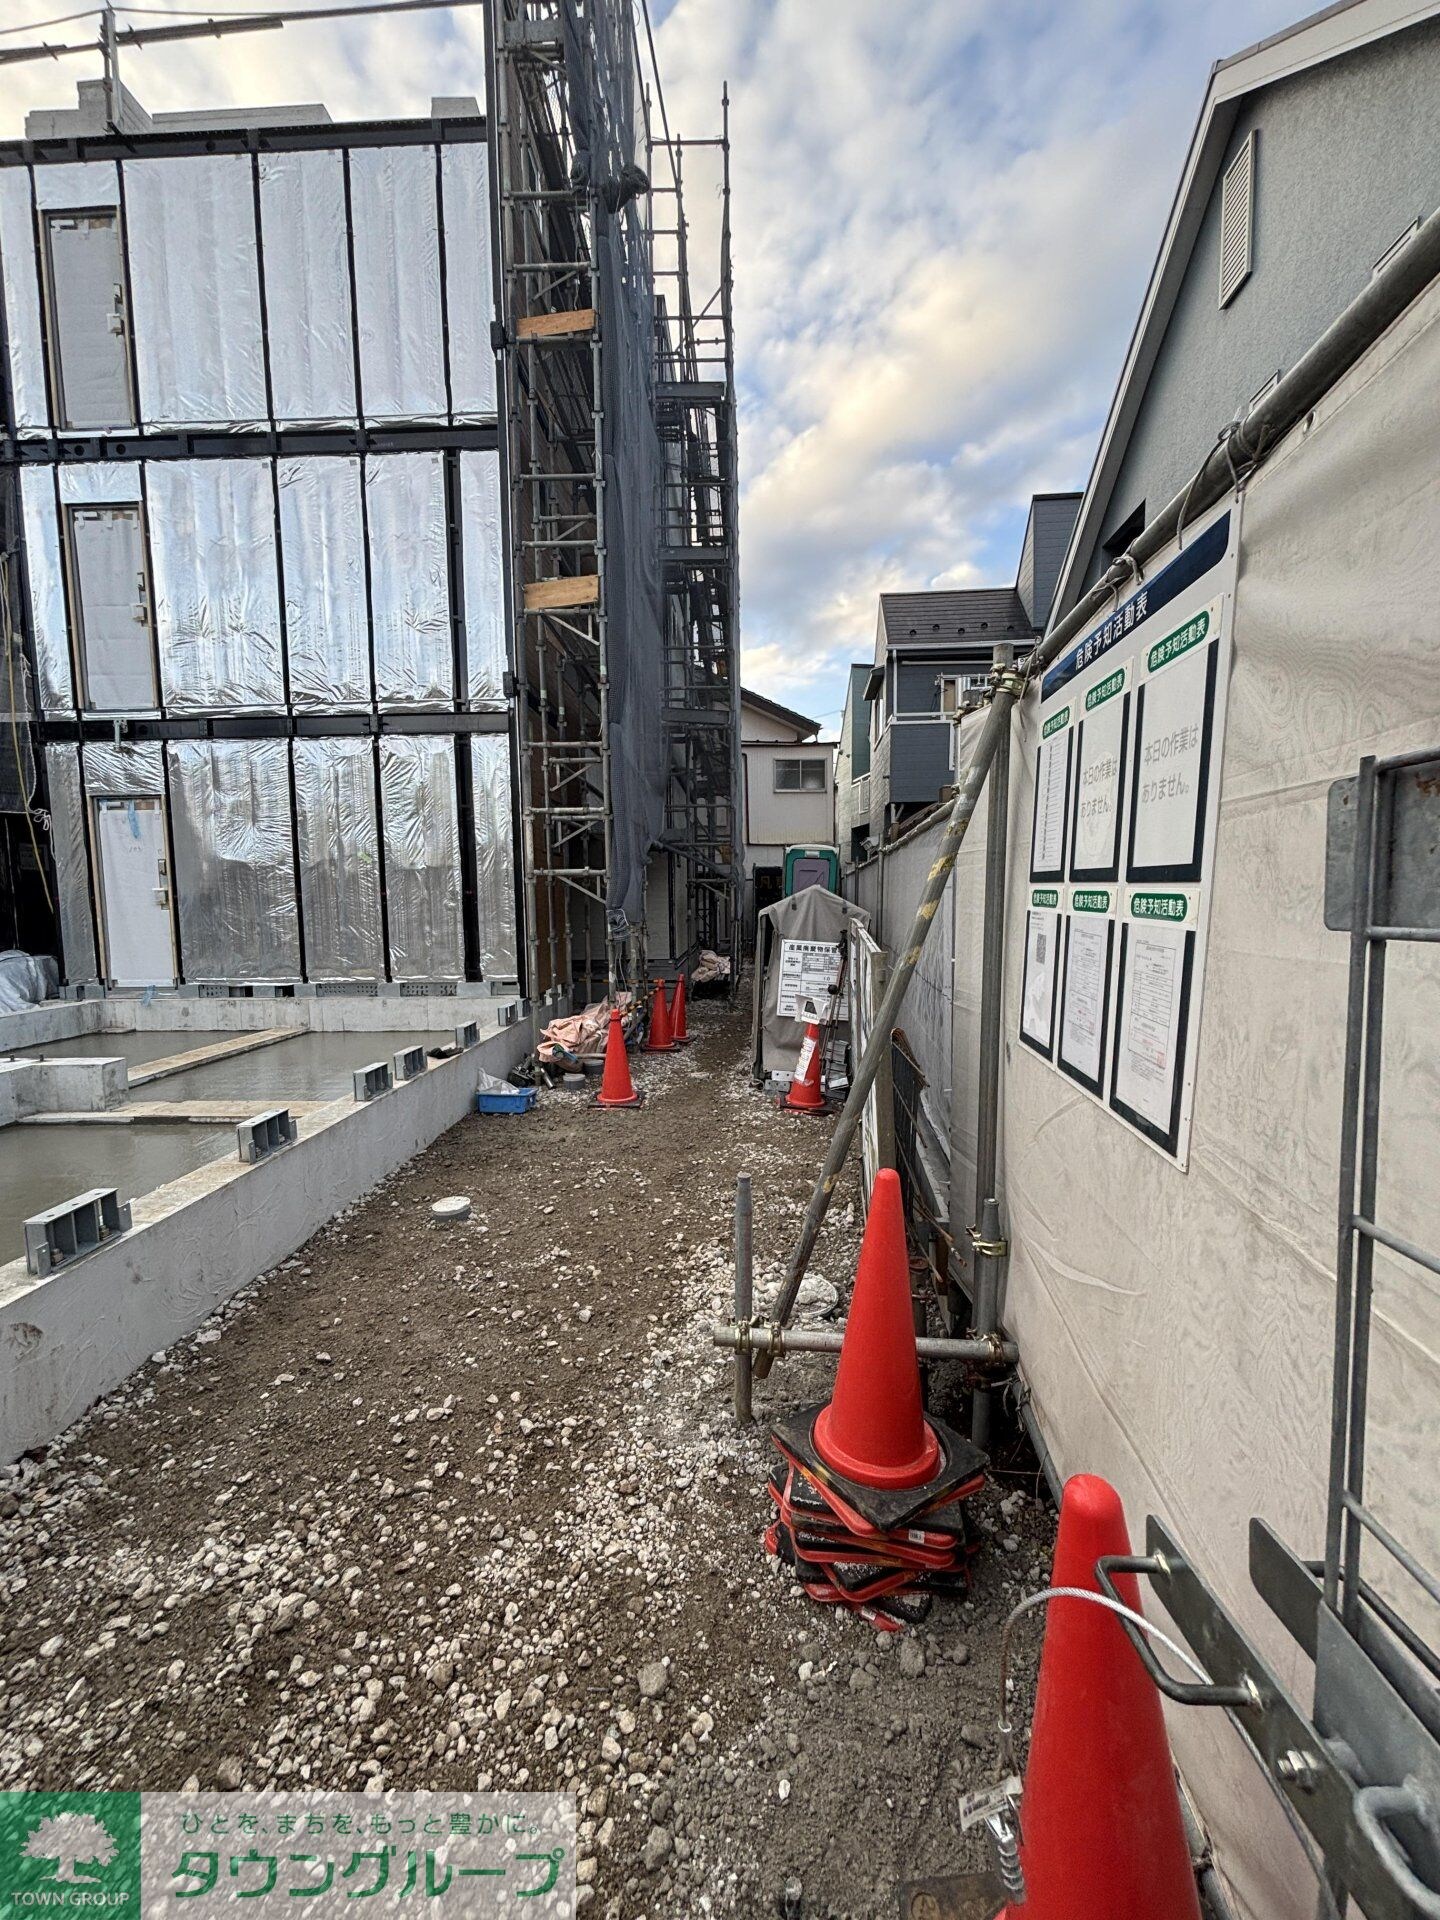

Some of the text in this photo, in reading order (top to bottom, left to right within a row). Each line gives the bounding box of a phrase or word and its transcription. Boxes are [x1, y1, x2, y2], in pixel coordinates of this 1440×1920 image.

[1076, 591, 1148, 670] 危険予知活動表
[1150, 617, 1206, 668] 危険予知活動表
[1144, 724, 1199, 766] 本日の作業は
[1082, 759, 1118, 786] 本日の作業は
[1141, 772, 1190, 803] ありません。
[1133, 897, 1185, 917] 危険予知活動表
